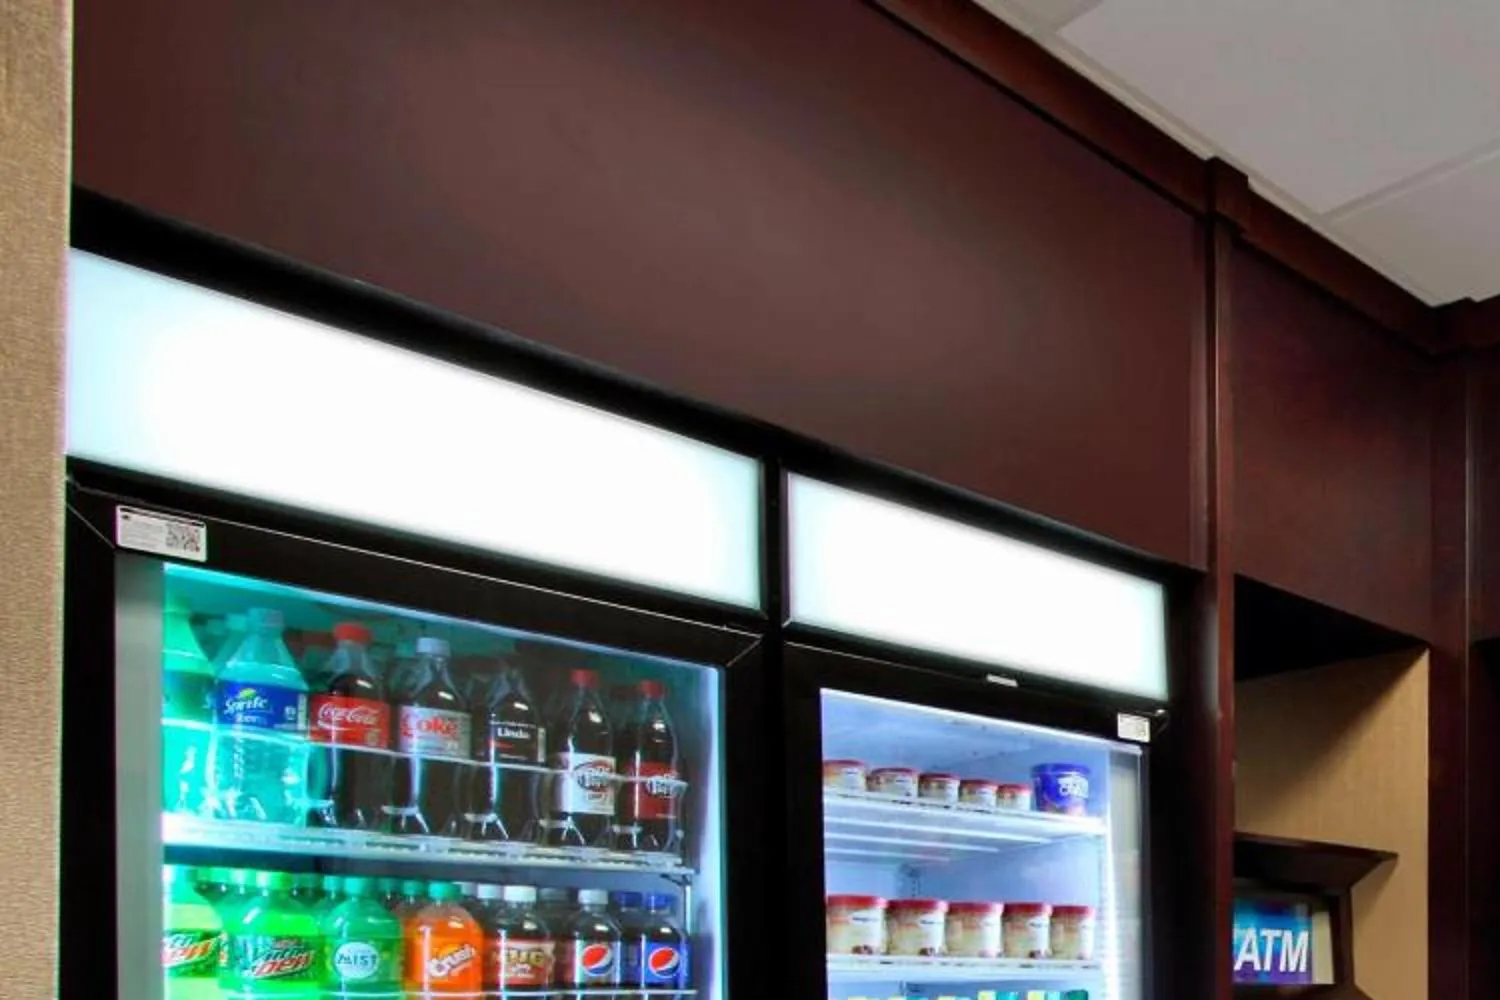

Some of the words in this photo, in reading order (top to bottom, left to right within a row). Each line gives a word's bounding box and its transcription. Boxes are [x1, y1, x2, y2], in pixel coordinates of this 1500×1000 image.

[318, 703, 380, 725] Coca-Cola
[427, 943, 476, 977] Crush
[1233, 925, 1309, 972] ATM
